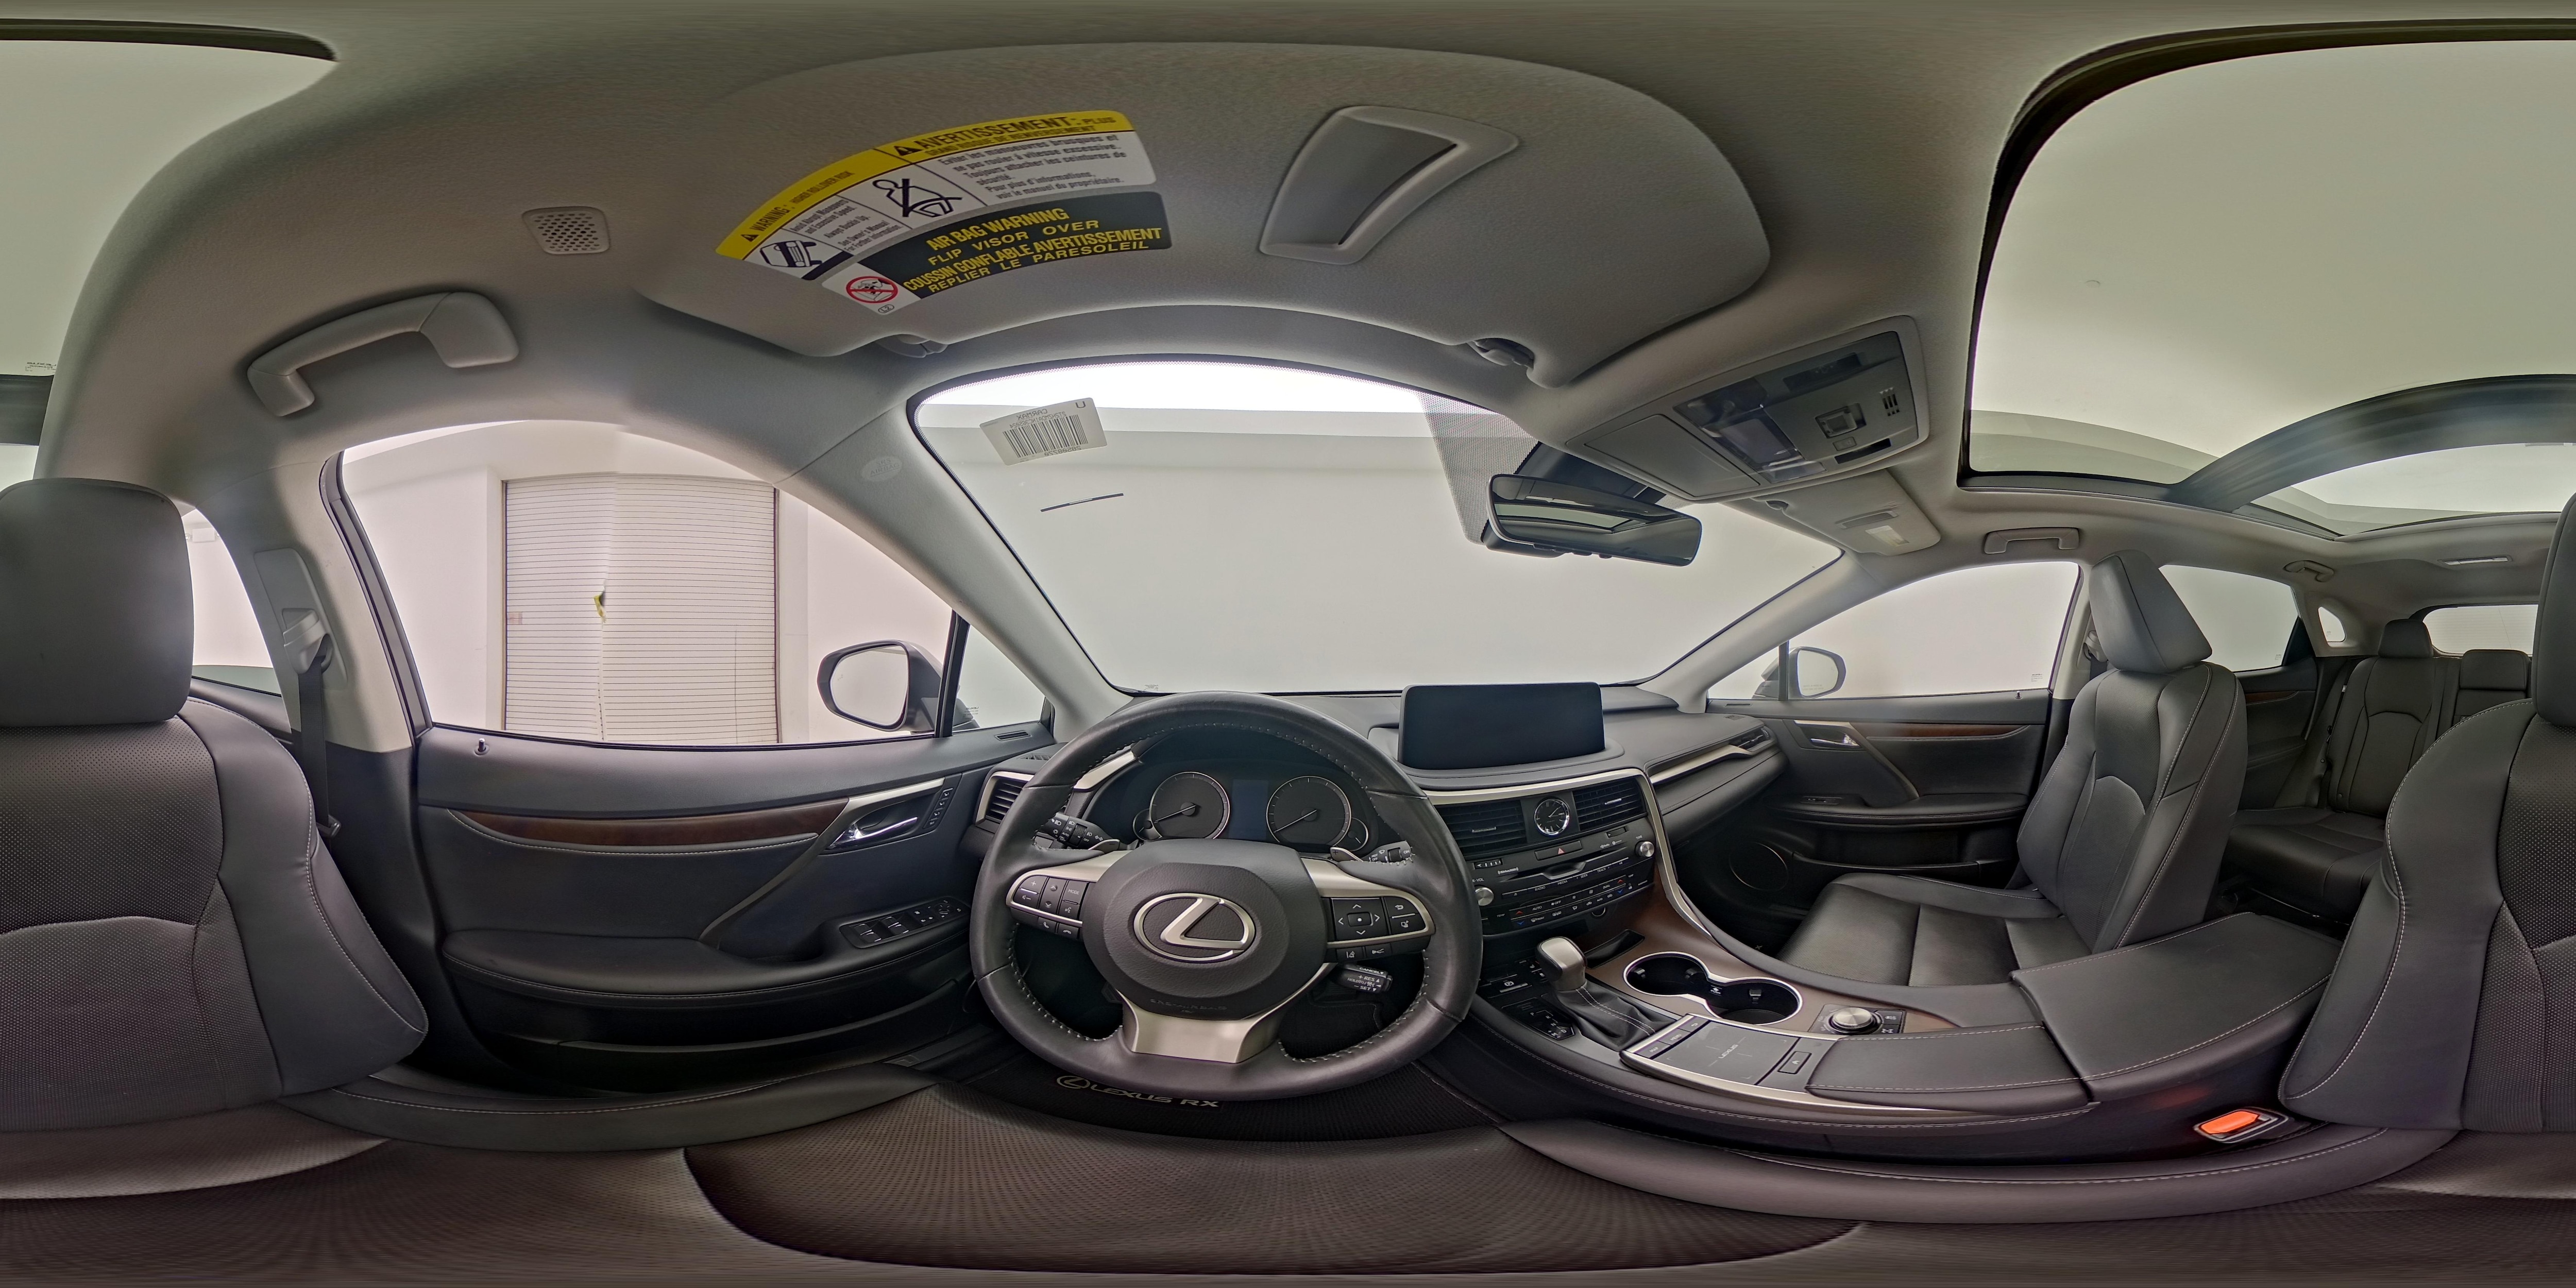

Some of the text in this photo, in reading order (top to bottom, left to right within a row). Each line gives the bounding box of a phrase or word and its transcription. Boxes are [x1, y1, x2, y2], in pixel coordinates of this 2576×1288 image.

[984, 156, 1014, 165] rouler
[1023, 149, 1061, 158] vitesse
[985, 142, 1049, 155] manoeuvres
[1049, 137, 1104, 146] brusques
[963, 167, 1005, 178] Toujours
[1005, 160, 1044, 170] attacher
[1063, 154, 1111, 162] ceintures
[789, 192, 810, 204] HIGHER
[807, 178, 838, 193] ROLLOVER
[1023, 184, 1055, 194] manuel
[926, 208, 1070, 250] AIR BAG WARNING
[928, 220, 1099, 267] FLIP VISOR OVER
[903, 227, 1161, 291] COUSSIN GONFLABLE AVERTISSEMENT
[928, 241, 1149, 293] REPLIER LE PARESOLEIL
[870, 463, 900, 475] AIRBAG
[1718, 1044, 1739, 1059] LEXUS
[1090, 1084, 1219, 1107] LEXUS RX
